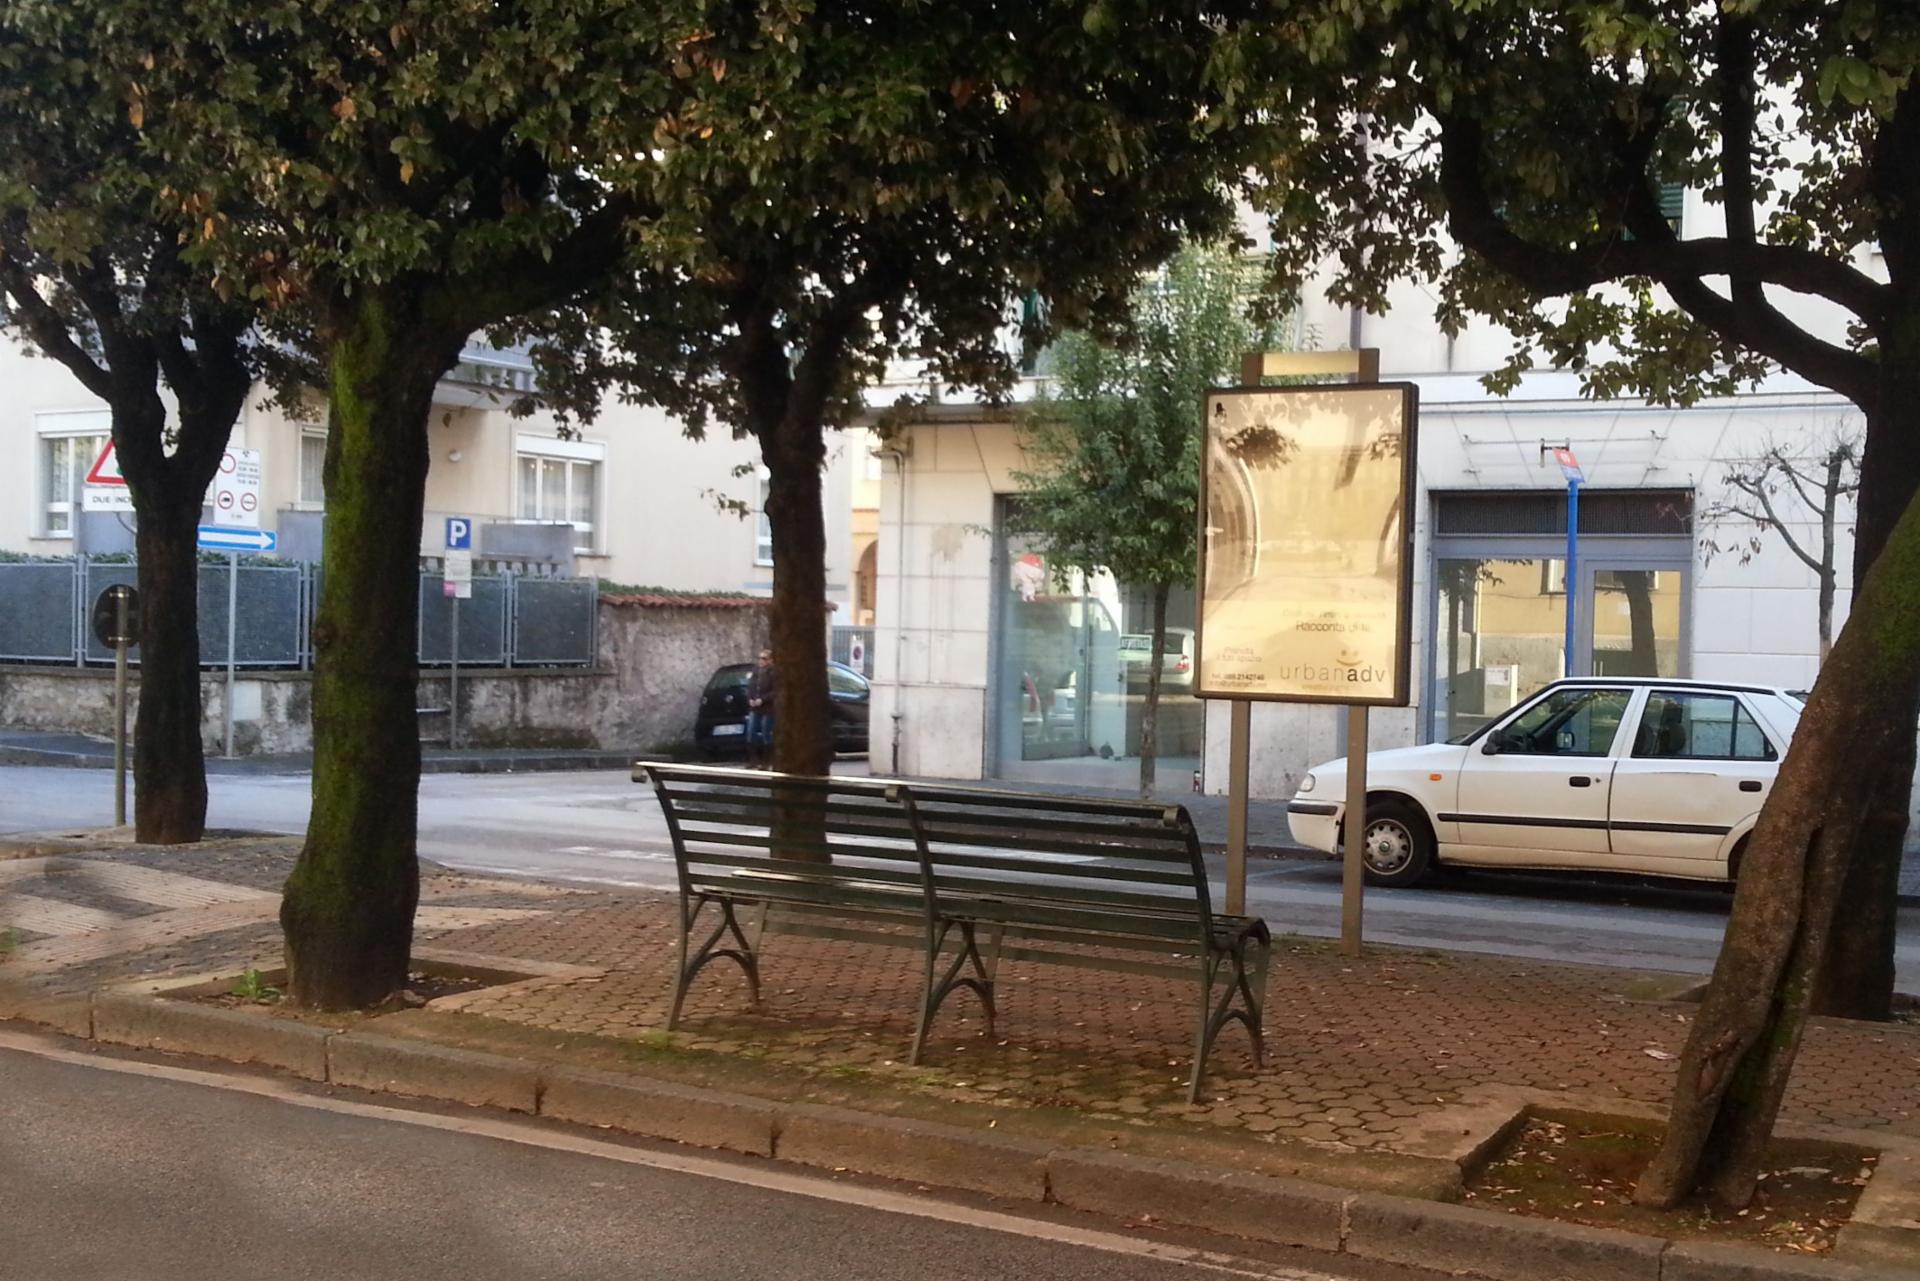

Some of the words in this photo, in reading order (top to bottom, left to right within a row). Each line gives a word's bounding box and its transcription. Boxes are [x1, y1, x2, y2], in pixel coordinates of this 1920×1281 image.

[92, 496, 110, 504] DUE
[450, 519, 467, 546] P
[1295, 621, 1345, 632] Racconta
[1280, 664, 1385, 682] urbanadv
